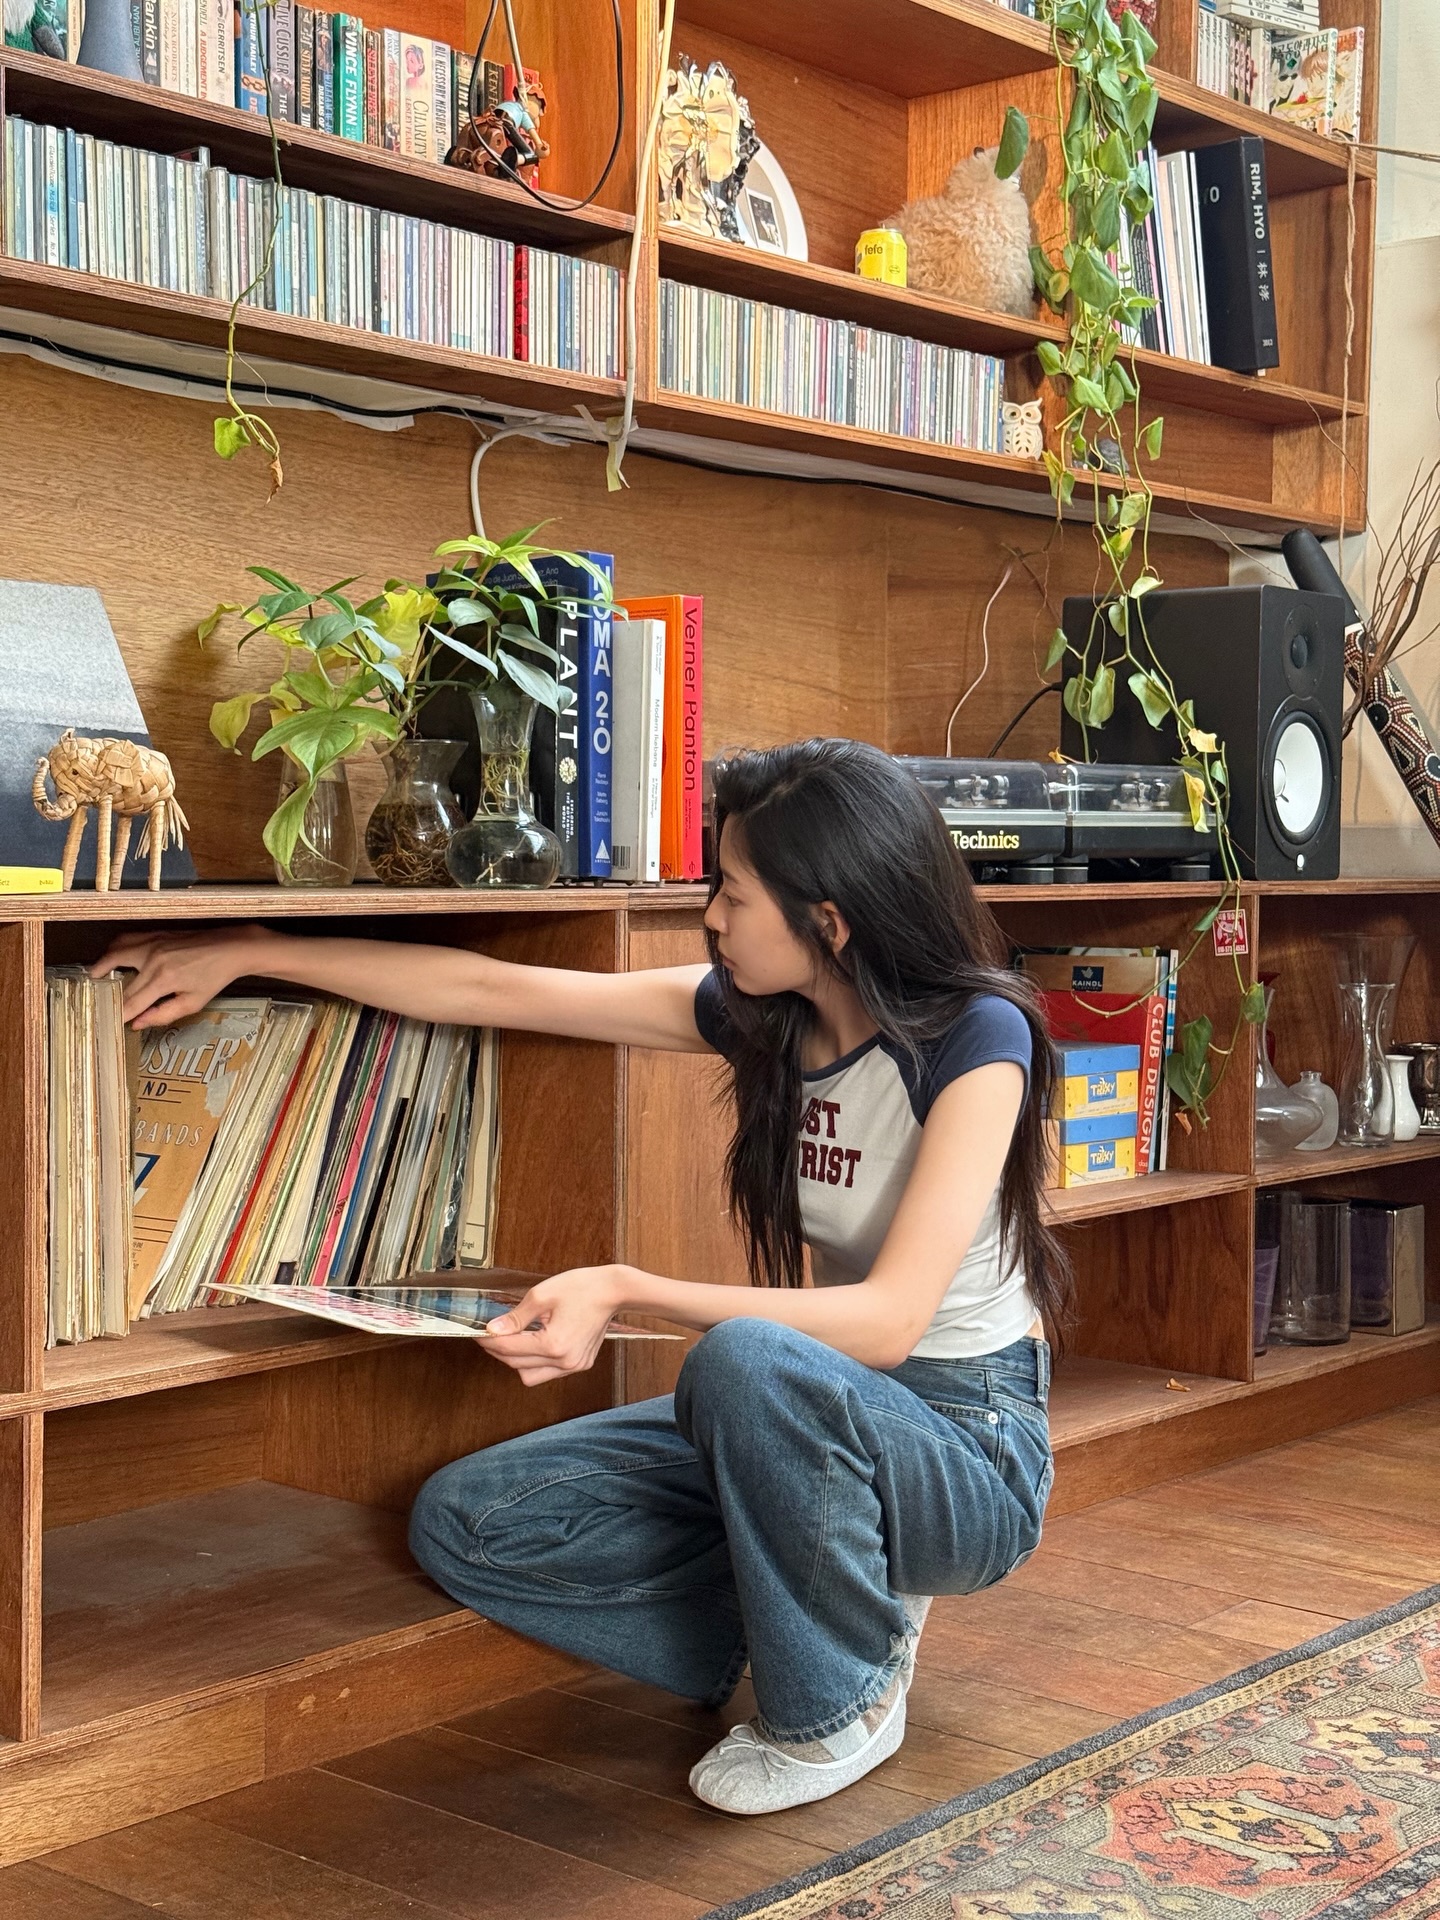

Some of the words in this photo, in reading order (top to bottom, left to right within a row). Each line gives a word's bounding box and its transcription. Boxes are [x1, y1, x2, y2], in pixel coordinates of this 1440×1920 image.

[217, 22, 226, 74] GERRITSEN
[275, 28, 291, 75] CUSSLER
[345, 31, 358, 77] VINCE
[435, 46, 446, 58] ALL
[435, 59, 446, 98] NECESSARY
[488, 69, 498, 94] KEN
[279, 94, 288, 114] THE
[345, 79, 358, 125] FLYNN
[435, 99, 446, 135] MEASURES
[318, 117, 325, 128] OF
[412, 100, 430, 158] CHARITY
[48, 189, 57, 212] Musical
[1250, 163, 1263, 201] RIM,
[49, 215, 57, 236] Series
[1253, 204, 1266, 239] HYO
[49, 241, 57, 257] No.6
[590, 563, 612, 678] NOMA
[684, 607, 697, 692] Verner
[684, 701, 697, 791] Panton
[950, 829, 1020, 849] Technics
[1149, 1002, 1166, 1059] CLUB
[139, 1027, 242, 1084] SHER
[139, 1080, 168, 1096] ND
[799, 1096, 841, 1138] ST
[1139, 1068, 1159, 1154] DESIGN
[134, 1120, 204, 1147] BANDS
[799, 1140, 862, 1188] RIST
[462, 1240, 475, 1250] Engel
